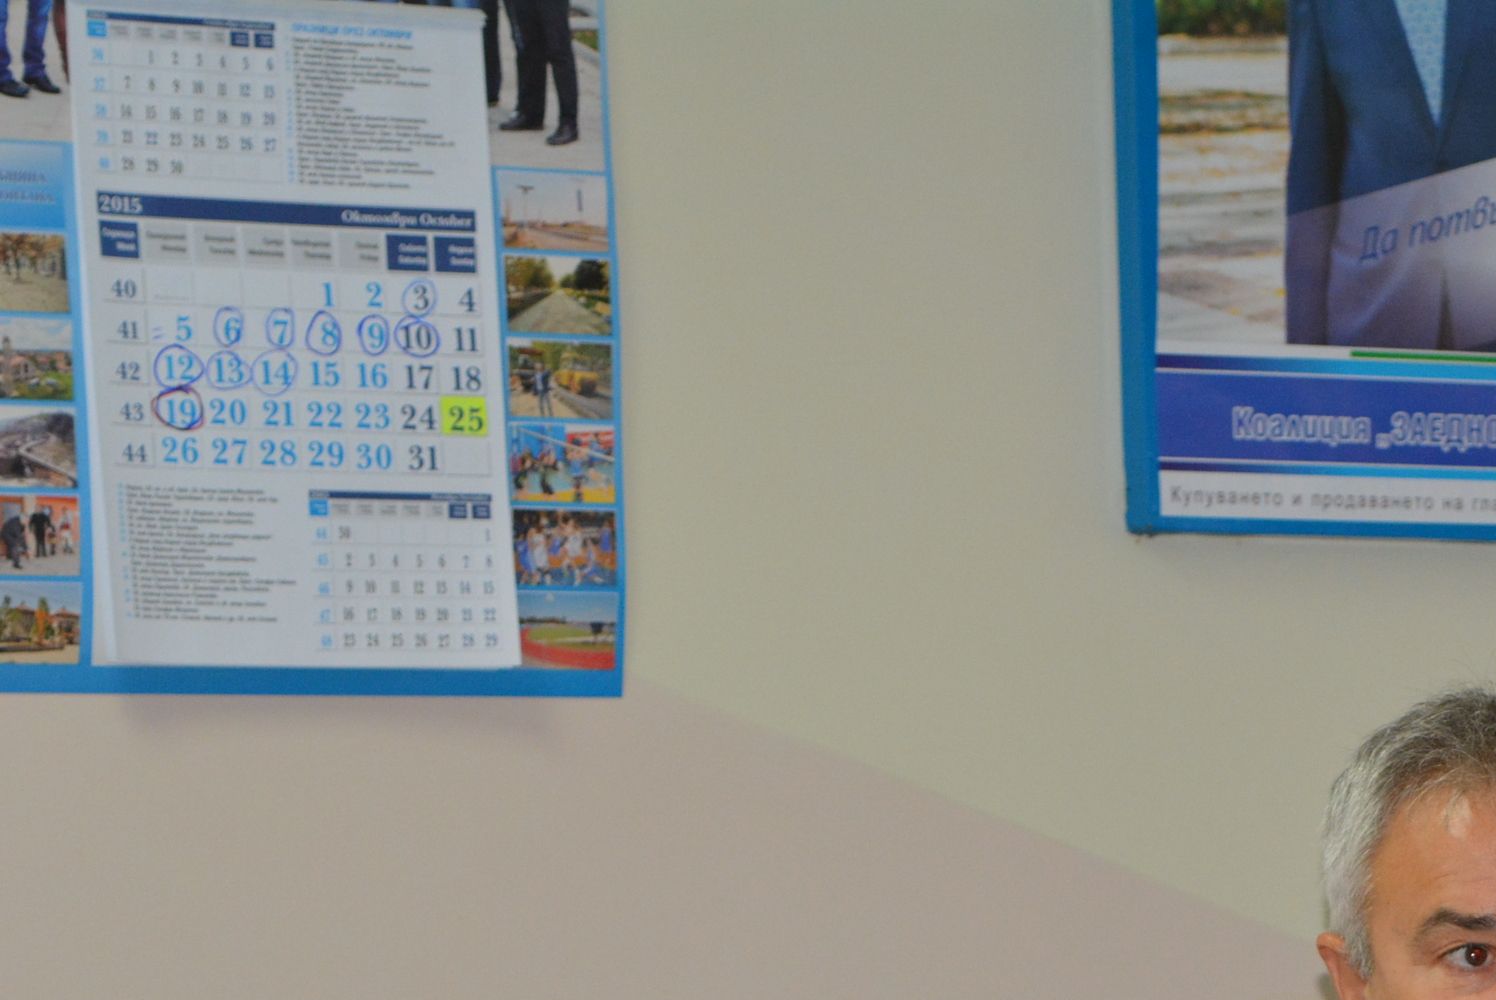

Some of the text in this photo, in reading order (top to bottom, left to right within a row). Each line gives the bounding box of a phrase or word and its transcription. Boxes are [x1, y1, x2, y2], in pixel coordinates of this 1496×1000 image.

[98, 193, 144, 213] 2015
[419, 213, 473, 227] October
[1359, 223, 1401, 262] Да
[112, 279, 477, 312] 40 1 2 3 4
[117, 315, 478, 352] 41 5 6 7 8 9 10 11
[115, 355, 482, 392] 42 12 13 14 15 16 17 18
[120, 398, 484, 432] 43 19 20 21 22 23 24 25
[1232, 405, 1372, 447] Коалиция
[122, 436, 438, 471] 44 26 27 28 29 30 31
